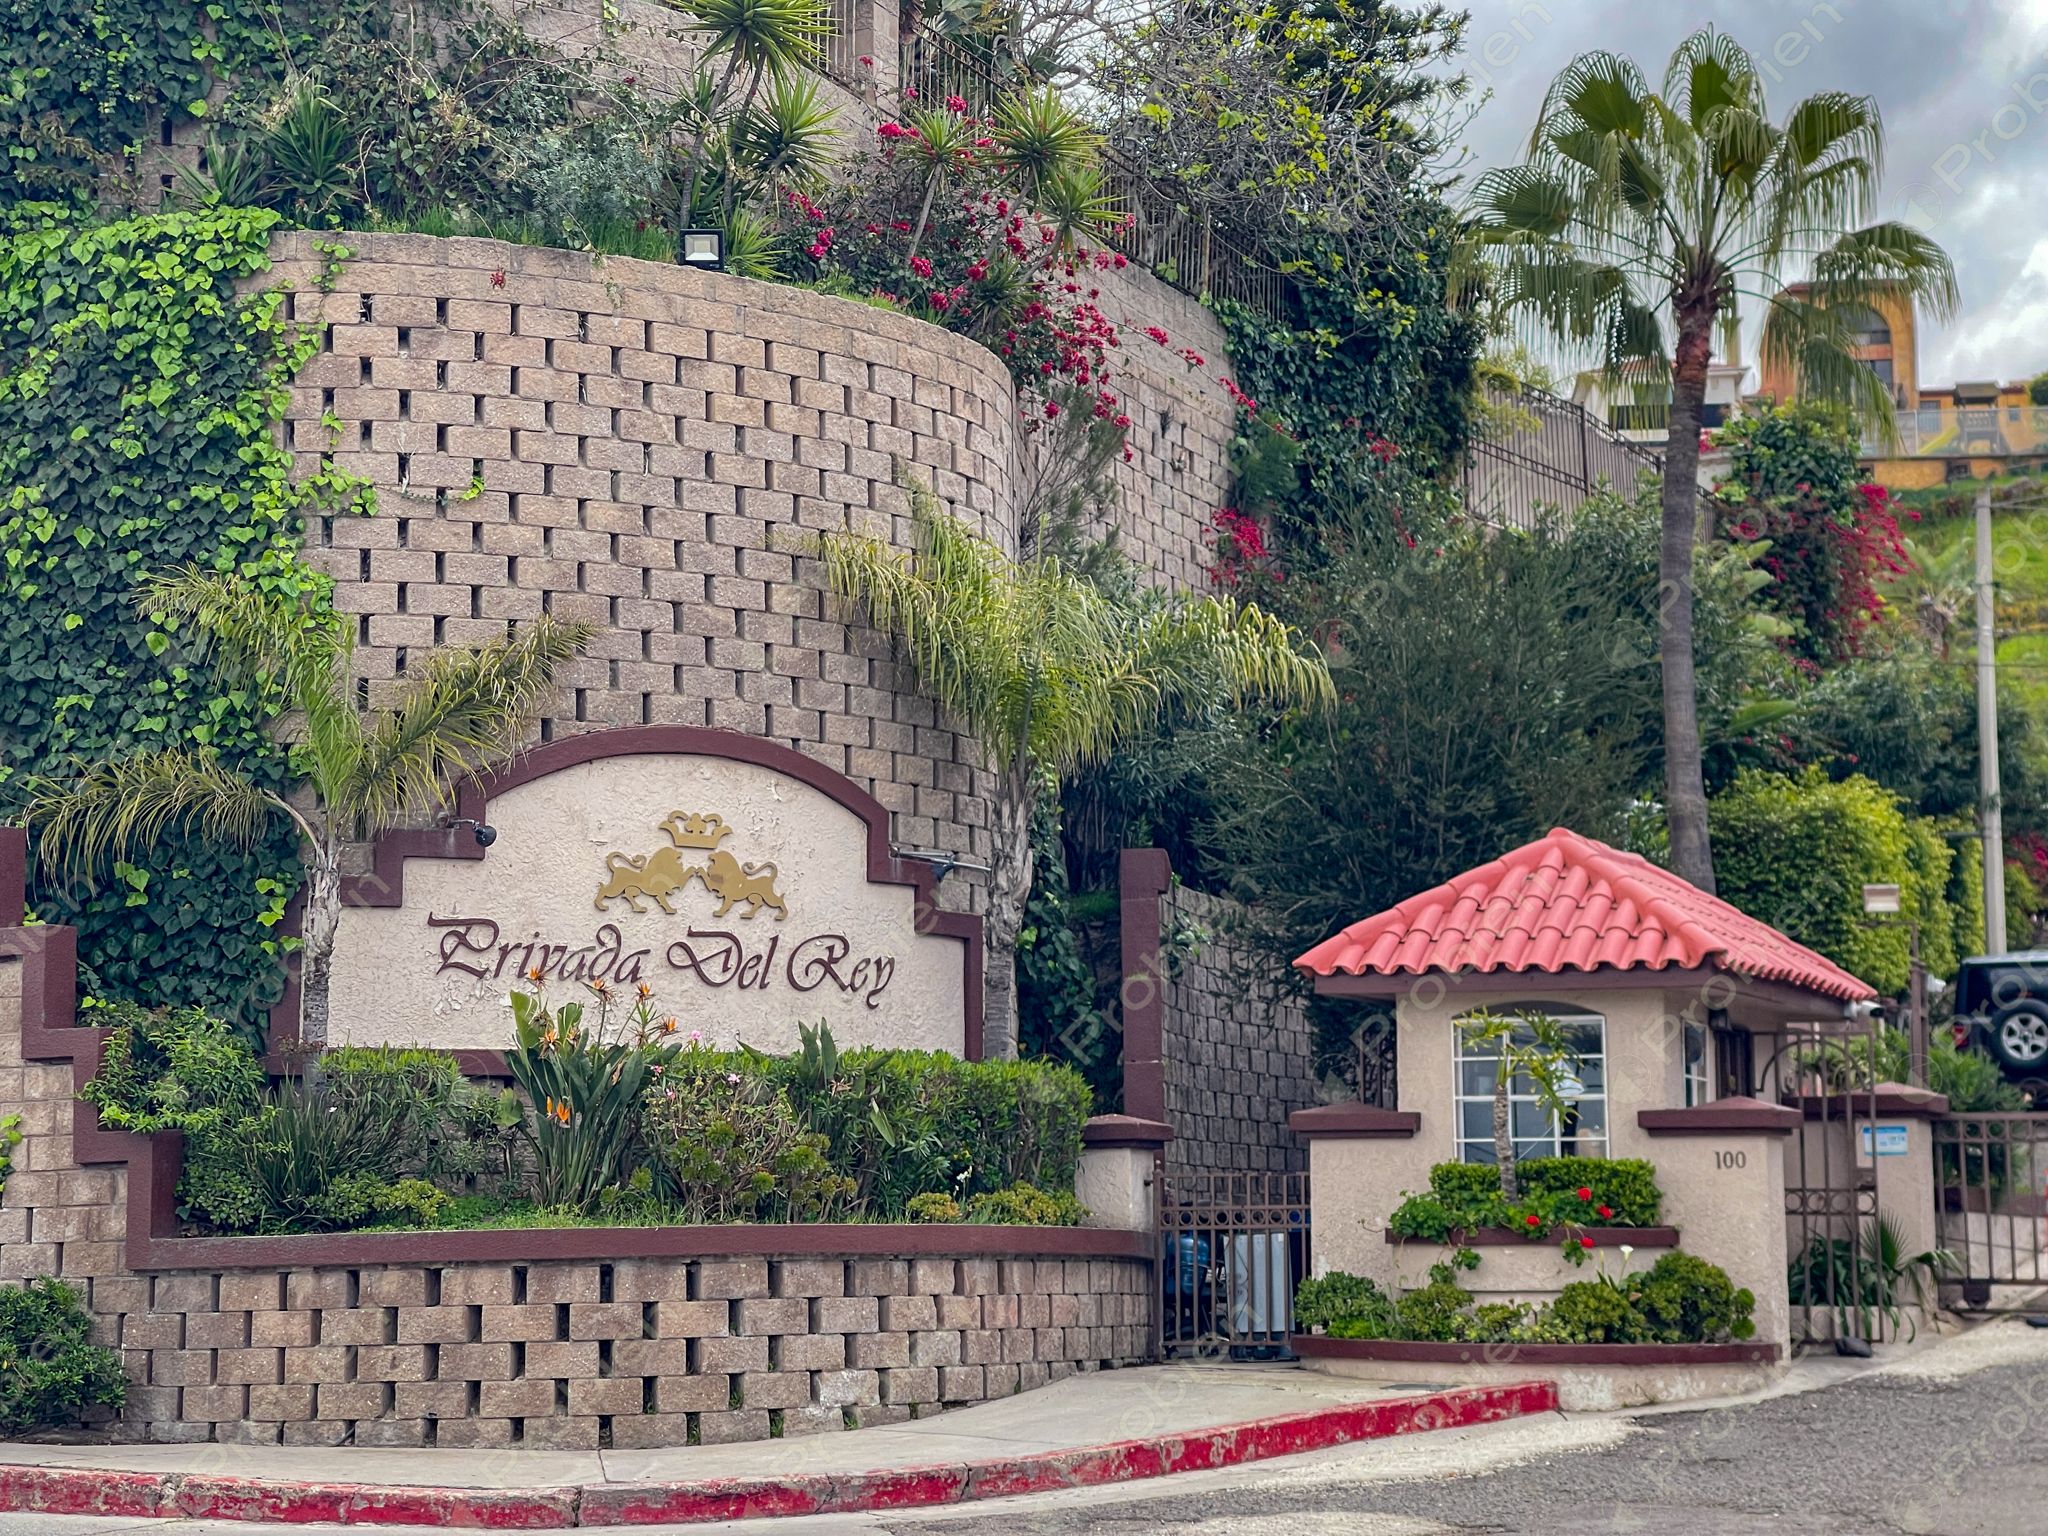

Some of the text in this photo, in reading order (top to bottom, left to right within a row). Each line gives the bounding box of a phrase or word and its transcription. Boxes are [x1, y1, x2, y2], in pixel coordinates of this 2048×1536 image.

[427, 911, 895, 1009] Privada Del Rey
[1714, 1150, 1747, 1169] 100
